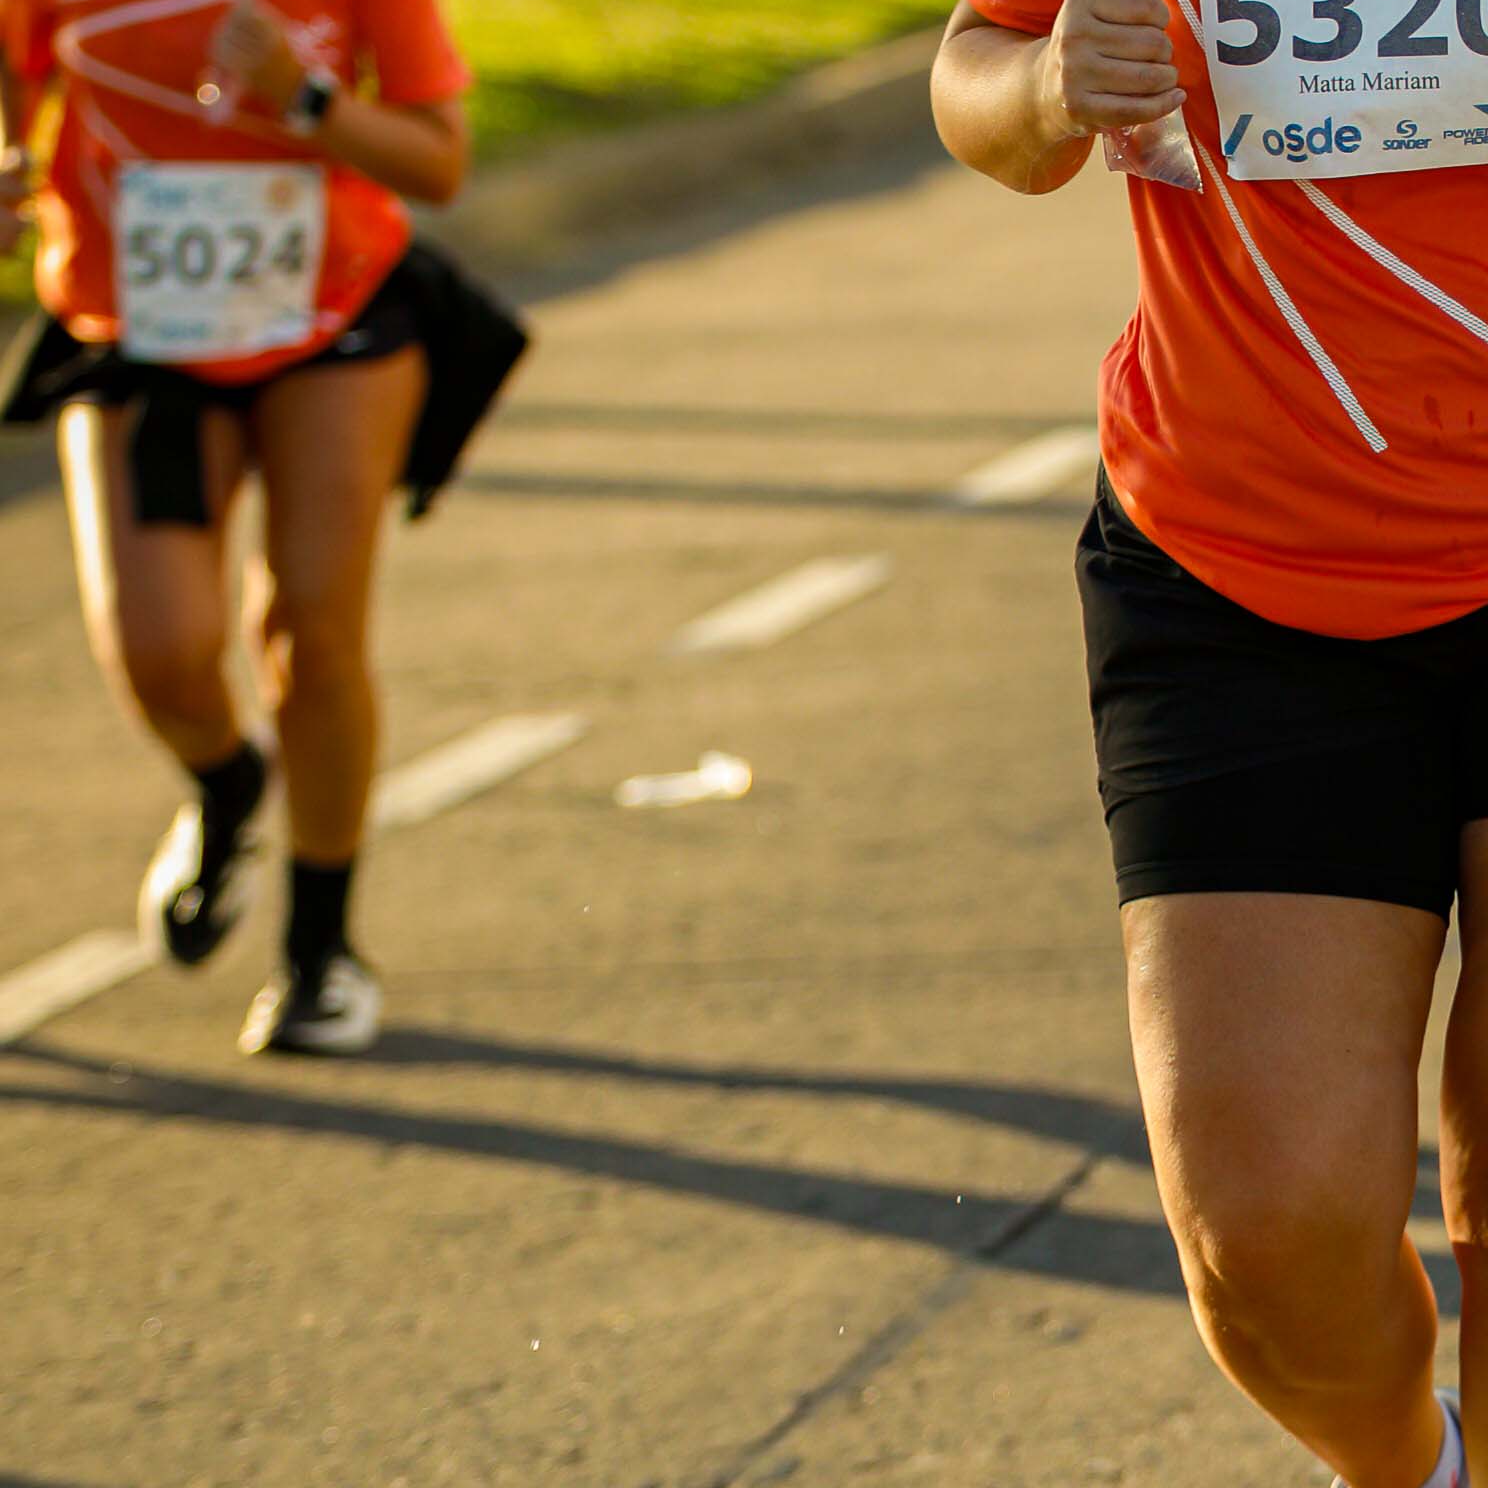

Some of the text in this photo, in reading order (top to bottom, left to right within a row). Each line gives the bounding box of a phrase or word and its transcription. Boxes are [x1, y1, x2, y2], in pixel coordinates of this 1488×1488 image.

[1299, 71, 1441, 94] Matta Mariam
[1262, 116, 1362, 158] osde
[126, 222, 306, 288] 5024
